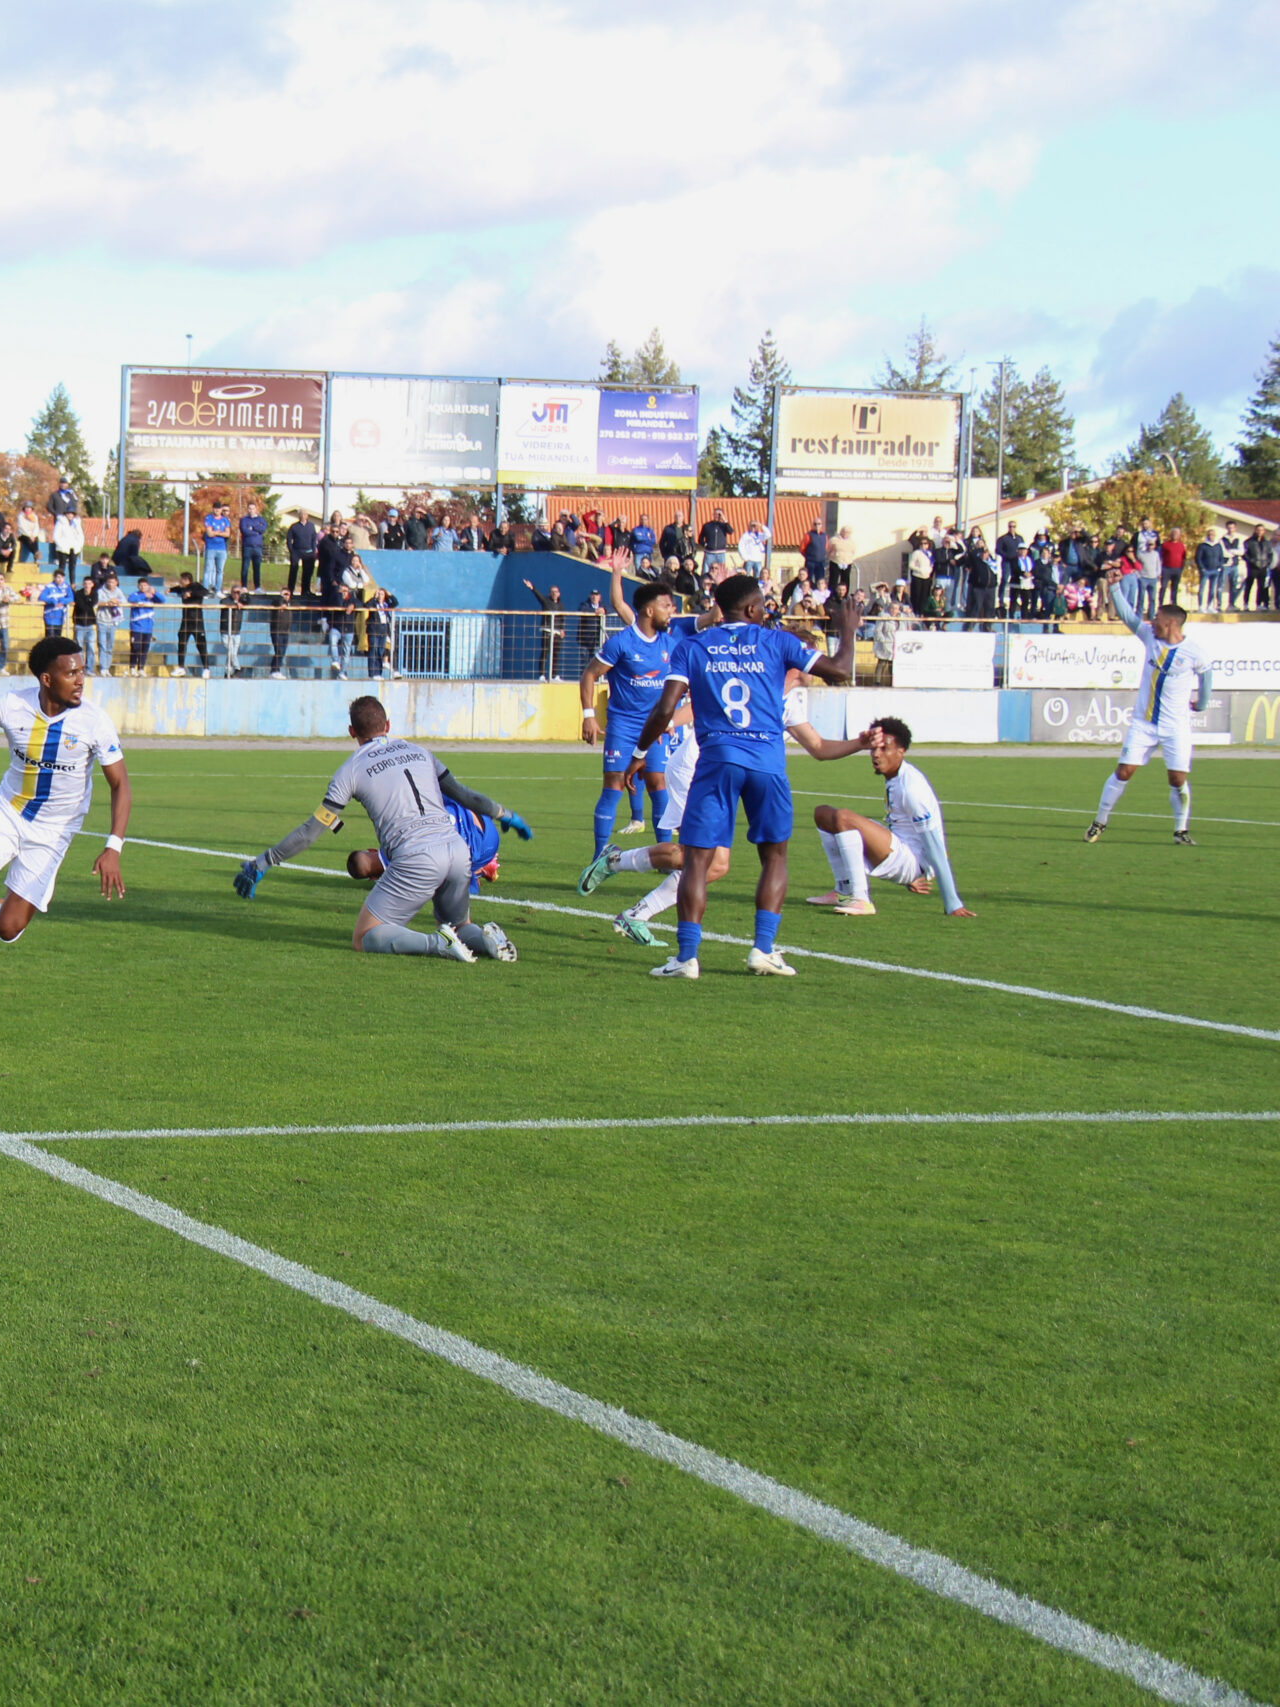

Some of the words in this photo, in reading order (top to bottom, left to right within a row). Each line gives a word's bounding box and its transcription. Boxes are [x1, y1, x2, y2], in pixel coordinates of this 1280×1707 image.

[133, 434, 226, 449] RESTAURANTE
[228, 437, 238, 449] E
[240, 437, 276, 450] TAKE
[276, 438, 316, 452] AWAY
[522, 440, 572, 450] VIDREIRA
[790, 434, 941, 457] restaurador
[504, 452, 524, 462] TUA
[528, 453, 590, 464] MIRANDELA
[878, 457, 908, 468] Desde
[910, 458, 935, 468] 1978
[1024, 645, 1076, 664] Galinha
[1084, 646, 1137, 670] Vizinha
[721, 677, 751, 730] 8
[1043, 696, 1069, 727] O
[1075, 695, 1135, 728] Abe
[366, 756, 396, 778] PEDRO
